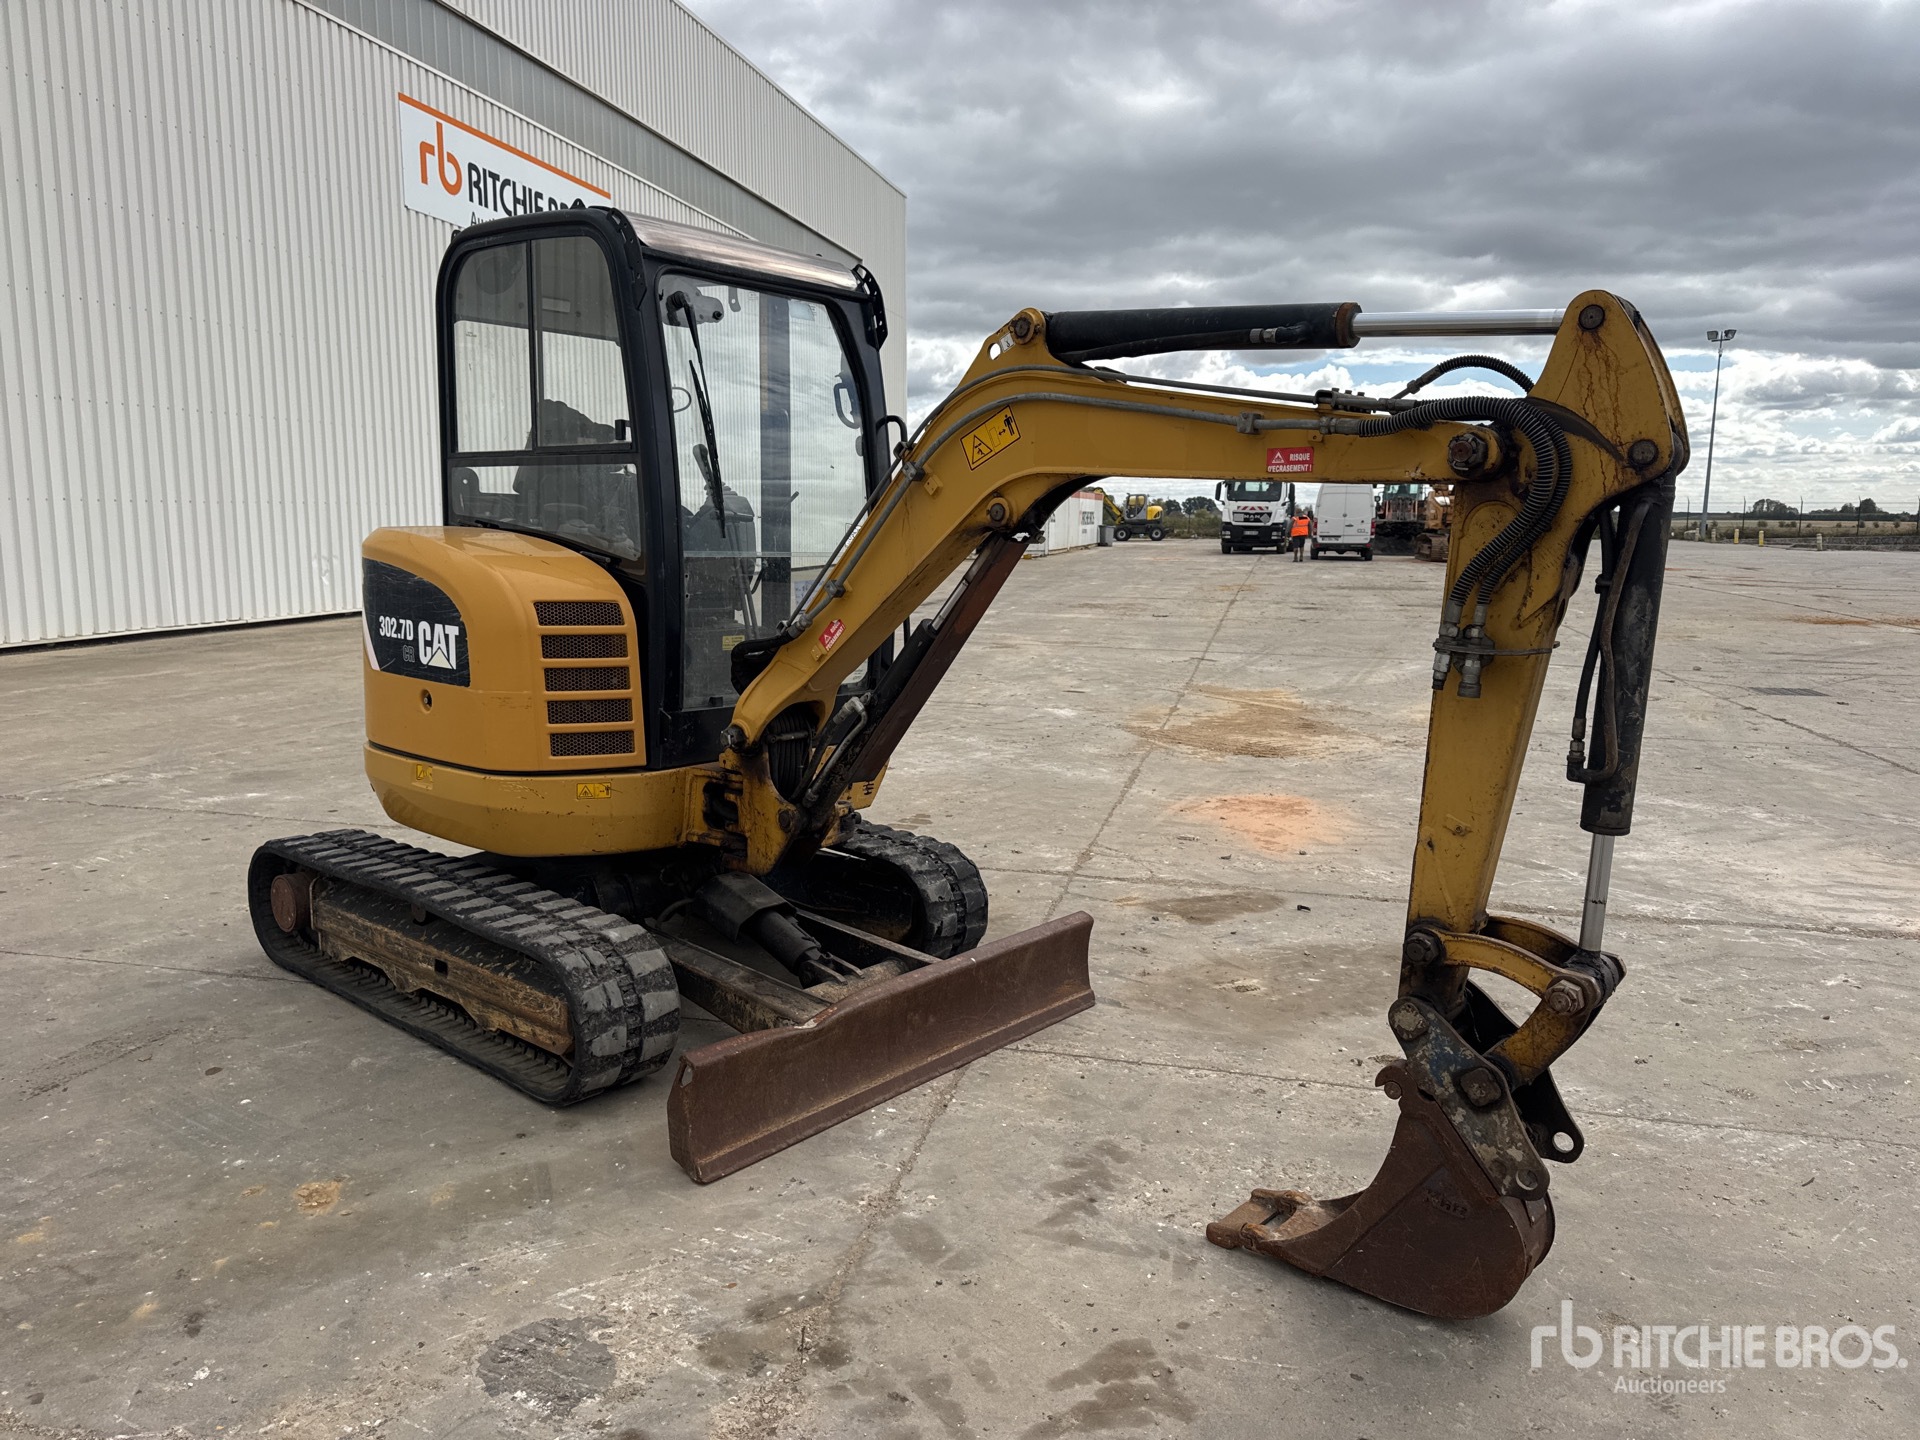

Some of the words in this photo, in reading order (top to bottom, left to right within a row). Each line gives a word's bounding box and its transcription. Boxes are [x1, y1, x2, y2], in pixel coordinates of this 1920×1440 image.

[419, 121, 462, 196] rb
[1289, 453, 1310, 461] RISQUE
[379, 615, 414, 641] 302.7D
[418, 620, 459, 670] CAT
[402, 644, 415, 663] CR
